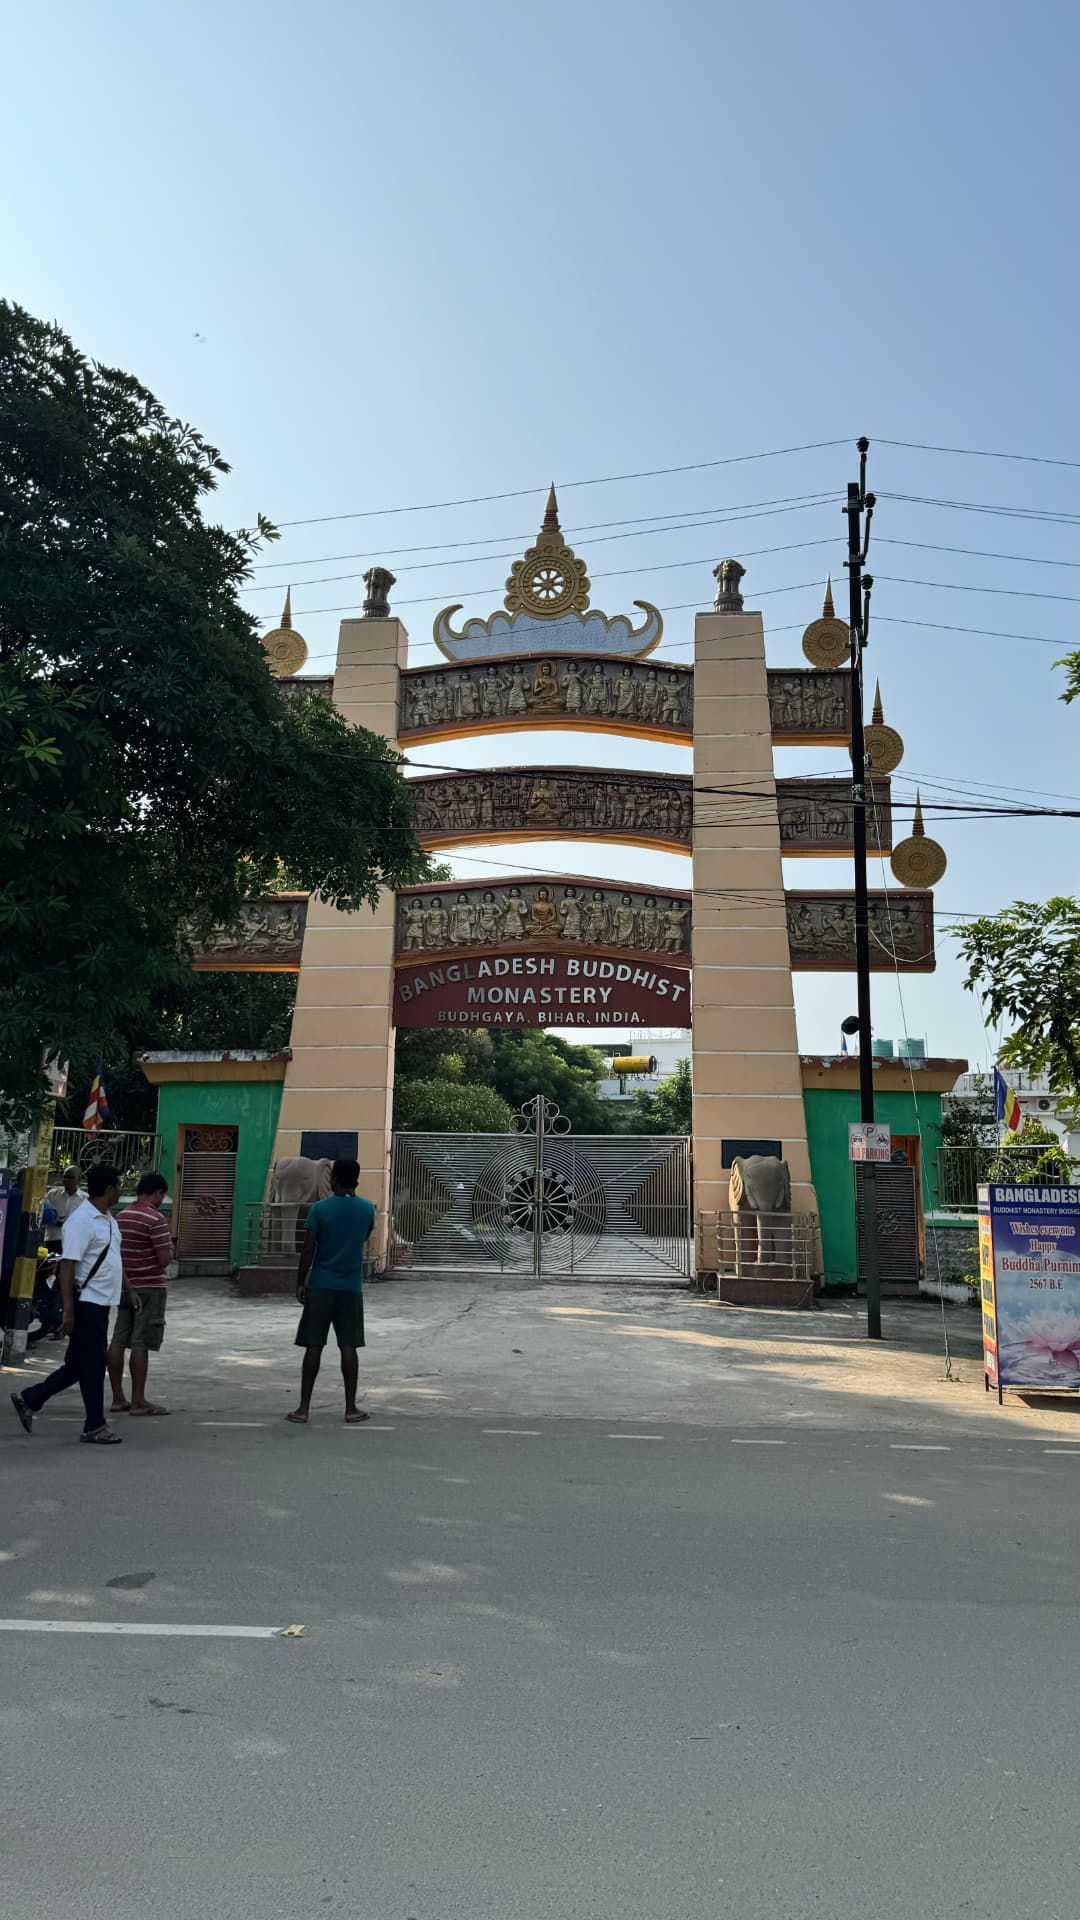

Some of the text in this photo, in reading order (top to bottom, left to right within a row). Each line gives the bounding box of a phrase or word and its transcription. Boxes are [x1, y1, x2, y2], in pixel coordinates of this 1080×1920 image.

[399, 957, 686, 1003] BANGLADESH BUDDHIST
[467, 987, 613, 1004] MONASTERY
[595, 1012, 645, 1023] INDIA.
[862, 1147, 889, 1159] PARKING
[993, 1206, 1022, 1214] BUDDHIST
[1023, 1207, 1057, 1215] MONASTERY
[1010, 1222, 1075, 1238] Wishes everyone
[1030, 1239, 1057, 1254] Happy
[1002, 1257, 1041, 1272] Buddha
[1030, 1279, 1047, 1289] 2567
